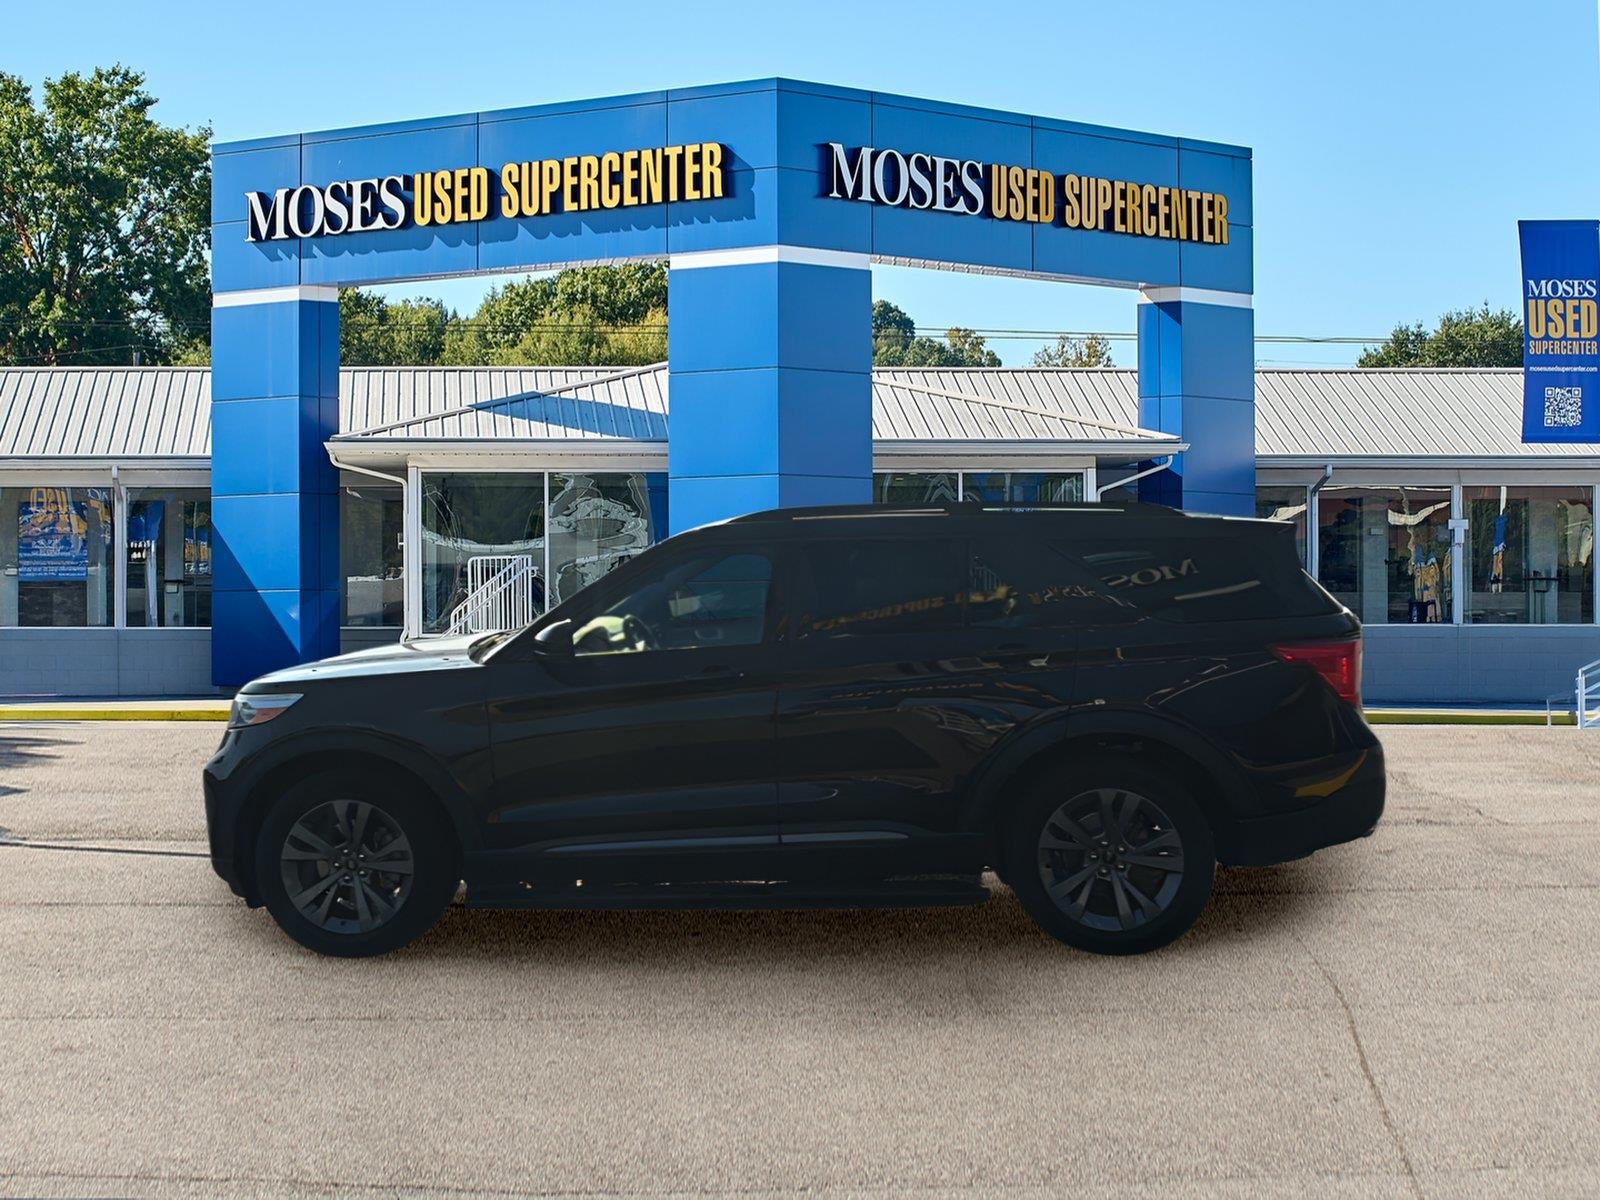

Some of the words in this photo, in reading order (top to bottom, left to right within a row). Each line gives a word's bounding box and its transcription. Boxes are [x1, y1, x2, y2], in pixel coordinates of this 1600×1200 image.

[244, 176, 406, 242] MOSES
[412, 168, 488, 227] USED
[500, 142, 725, 218] SUPERCENTER
[829, 142, 985, 215] MOSES
[990, 163, 1055, 224] USED
[1064, 172, 1230, 245] SUPERCENTER
[1527, 279, 1597, 298] MOSES
[1529, 299, 1597, 339] USED
[1529, 341, 1598, 355] SUPERCENTER
